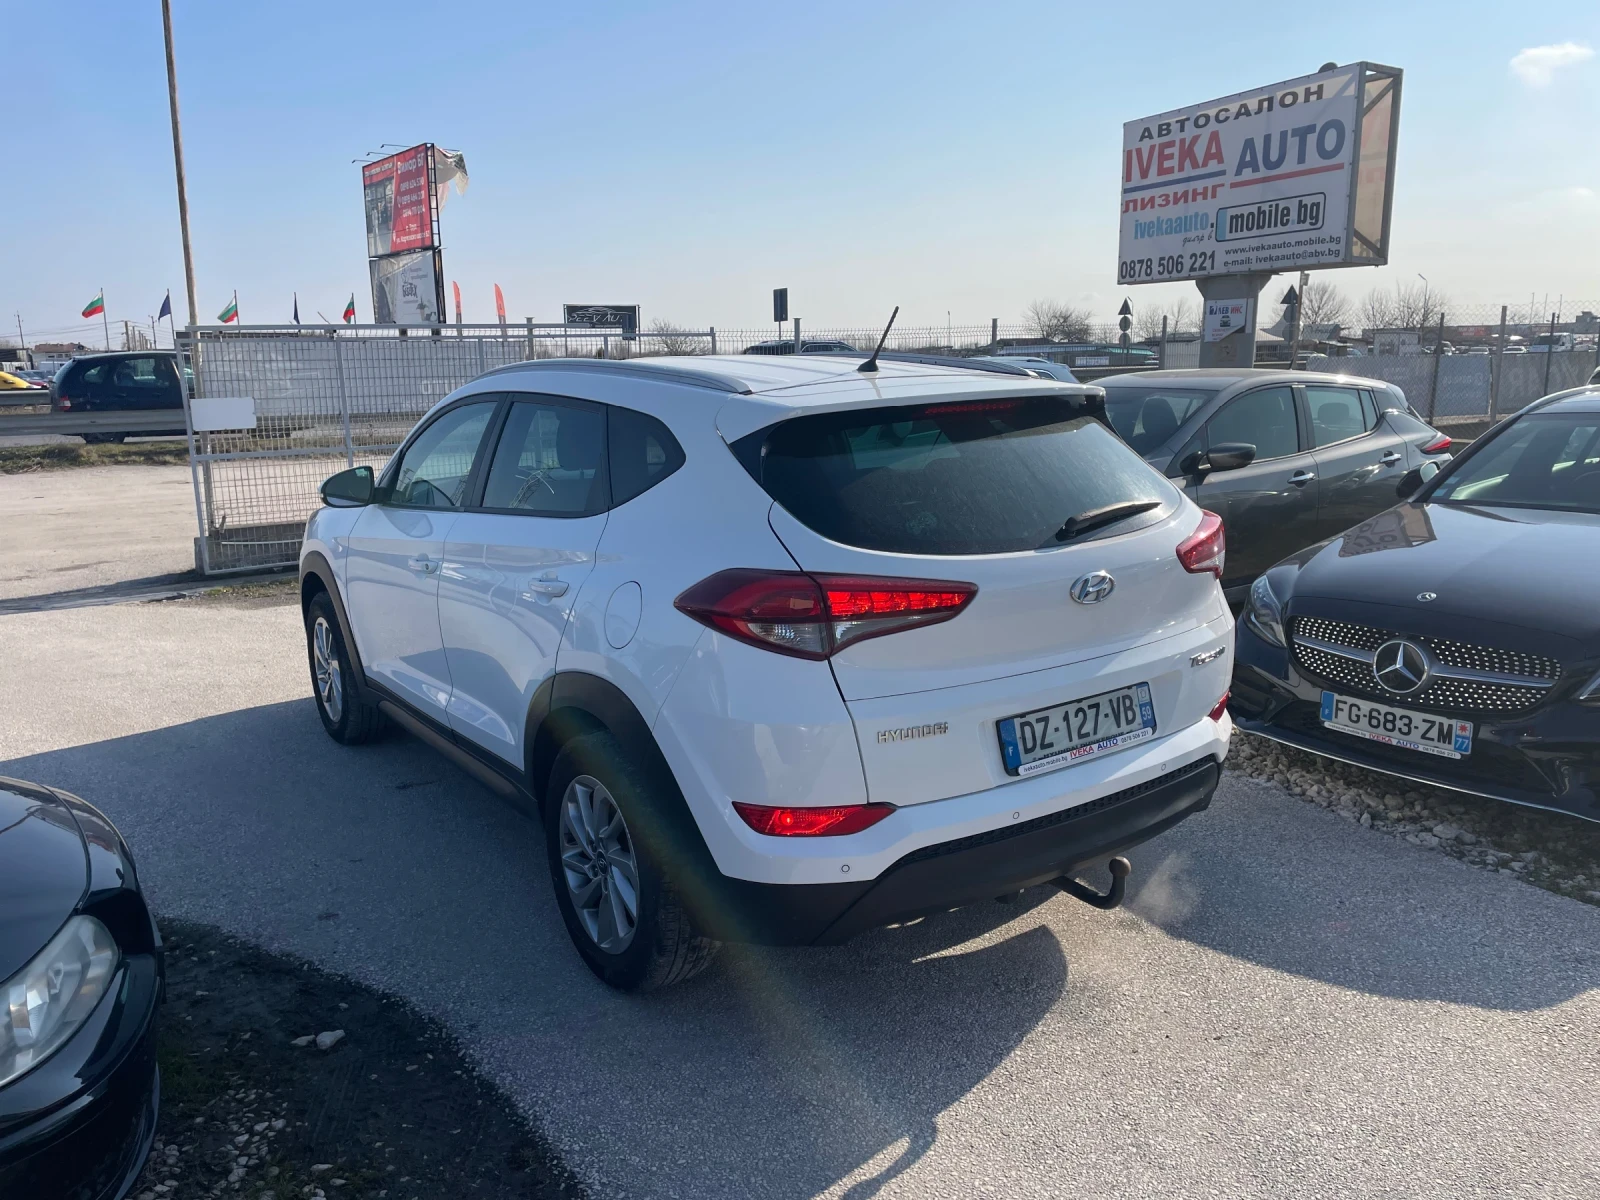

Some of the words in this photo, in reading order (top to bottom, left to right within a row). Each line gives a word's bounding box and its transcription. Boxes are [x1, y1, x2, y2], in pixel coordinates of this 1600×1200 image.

[1138, 84, 1325, 142] АВТОСАЛОН
[1125, 130, 1225, 183] IVEKA
[1234, 119, 1346, 176] AUTO
[1122, 183, 1225, 214] ЛИЗИНГ
[1229, 199, 1320, 234] mobile.bg
[1225, 235, 1341, 255] www.ivekaauto.mobile.bg
[1120, 257, 1153, 279] 0878
[1157, 254, 1184, 275] 506
[1189, 250, 1216, 272] 221
[1223, 257, 1253, 267] e-mail:
[1255, 248, 1340, 264] ivekaauto@abv.bg
[1141, 705, 1152, 720] 59
[877, 721, 949, 744] HYUNDAI
[1369, 733, 1393, 743] IVEKA
[1396, 740, 1420, 749] AUTO
[1456, 737, 1469, 750] 77
[1070, 745, 1095, 759] IVEKA
[1097, 738, 1119, 751] AUTO
